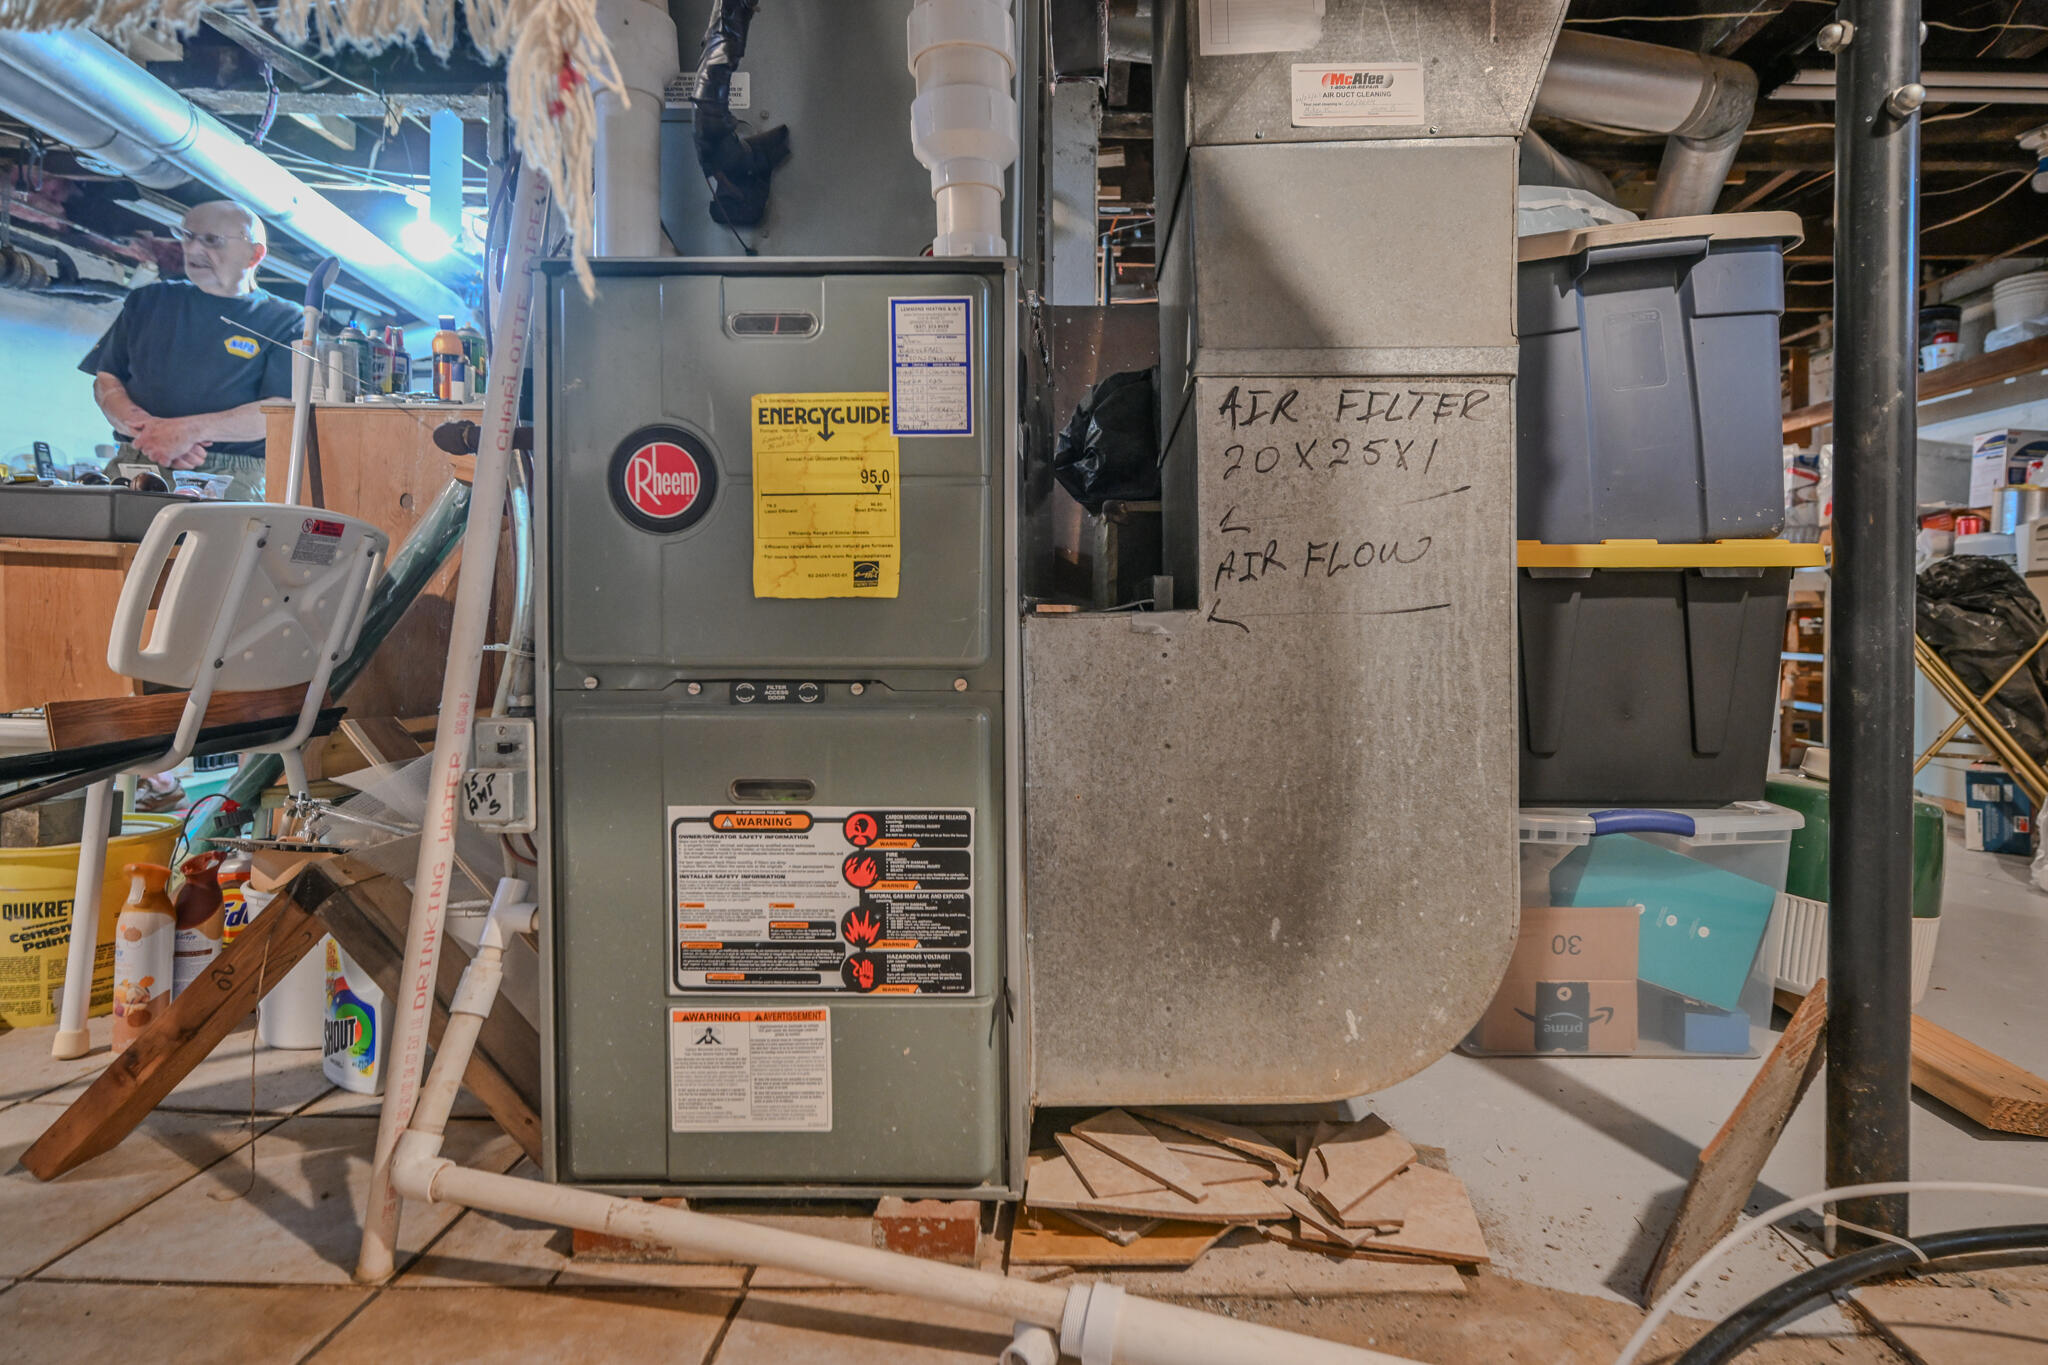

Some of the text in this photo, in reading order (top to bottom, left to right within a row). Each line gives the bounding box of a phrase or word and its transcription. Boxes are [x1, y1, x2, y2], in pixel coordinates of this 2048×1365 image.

[1330, 72, 1385, 86] McAfee
[1356, 90, 1392, 98] CLEANING
[496, 208, 539, 451] CHARLOTTE PIPE
[758, 406, 889, 425] ENERGYGUIDE
[1219, 386, 1490, 430] AIR FILTER
[634, 445, 695, 506] Rheem
[860, 469, 890, 484] 95.0
[1215, 536, 1432, 592] AIR FLOW
[736, 817, 792, 827] WARNING
[413, 751, 462, 1010] DRINKING WATER
[2, 899, 75, 921] QUIKRET
[9, 923, 72, 943] cemen
[1552, 934, 1583, 956] 30
[688, 1012, 740, 1022] WARNING
[764, 1012, 822, 1021] AVERTISSEMENT
[324, 1018, 356, 1057] SHOUT
[1543, 1021, 1584, 1037] prime
